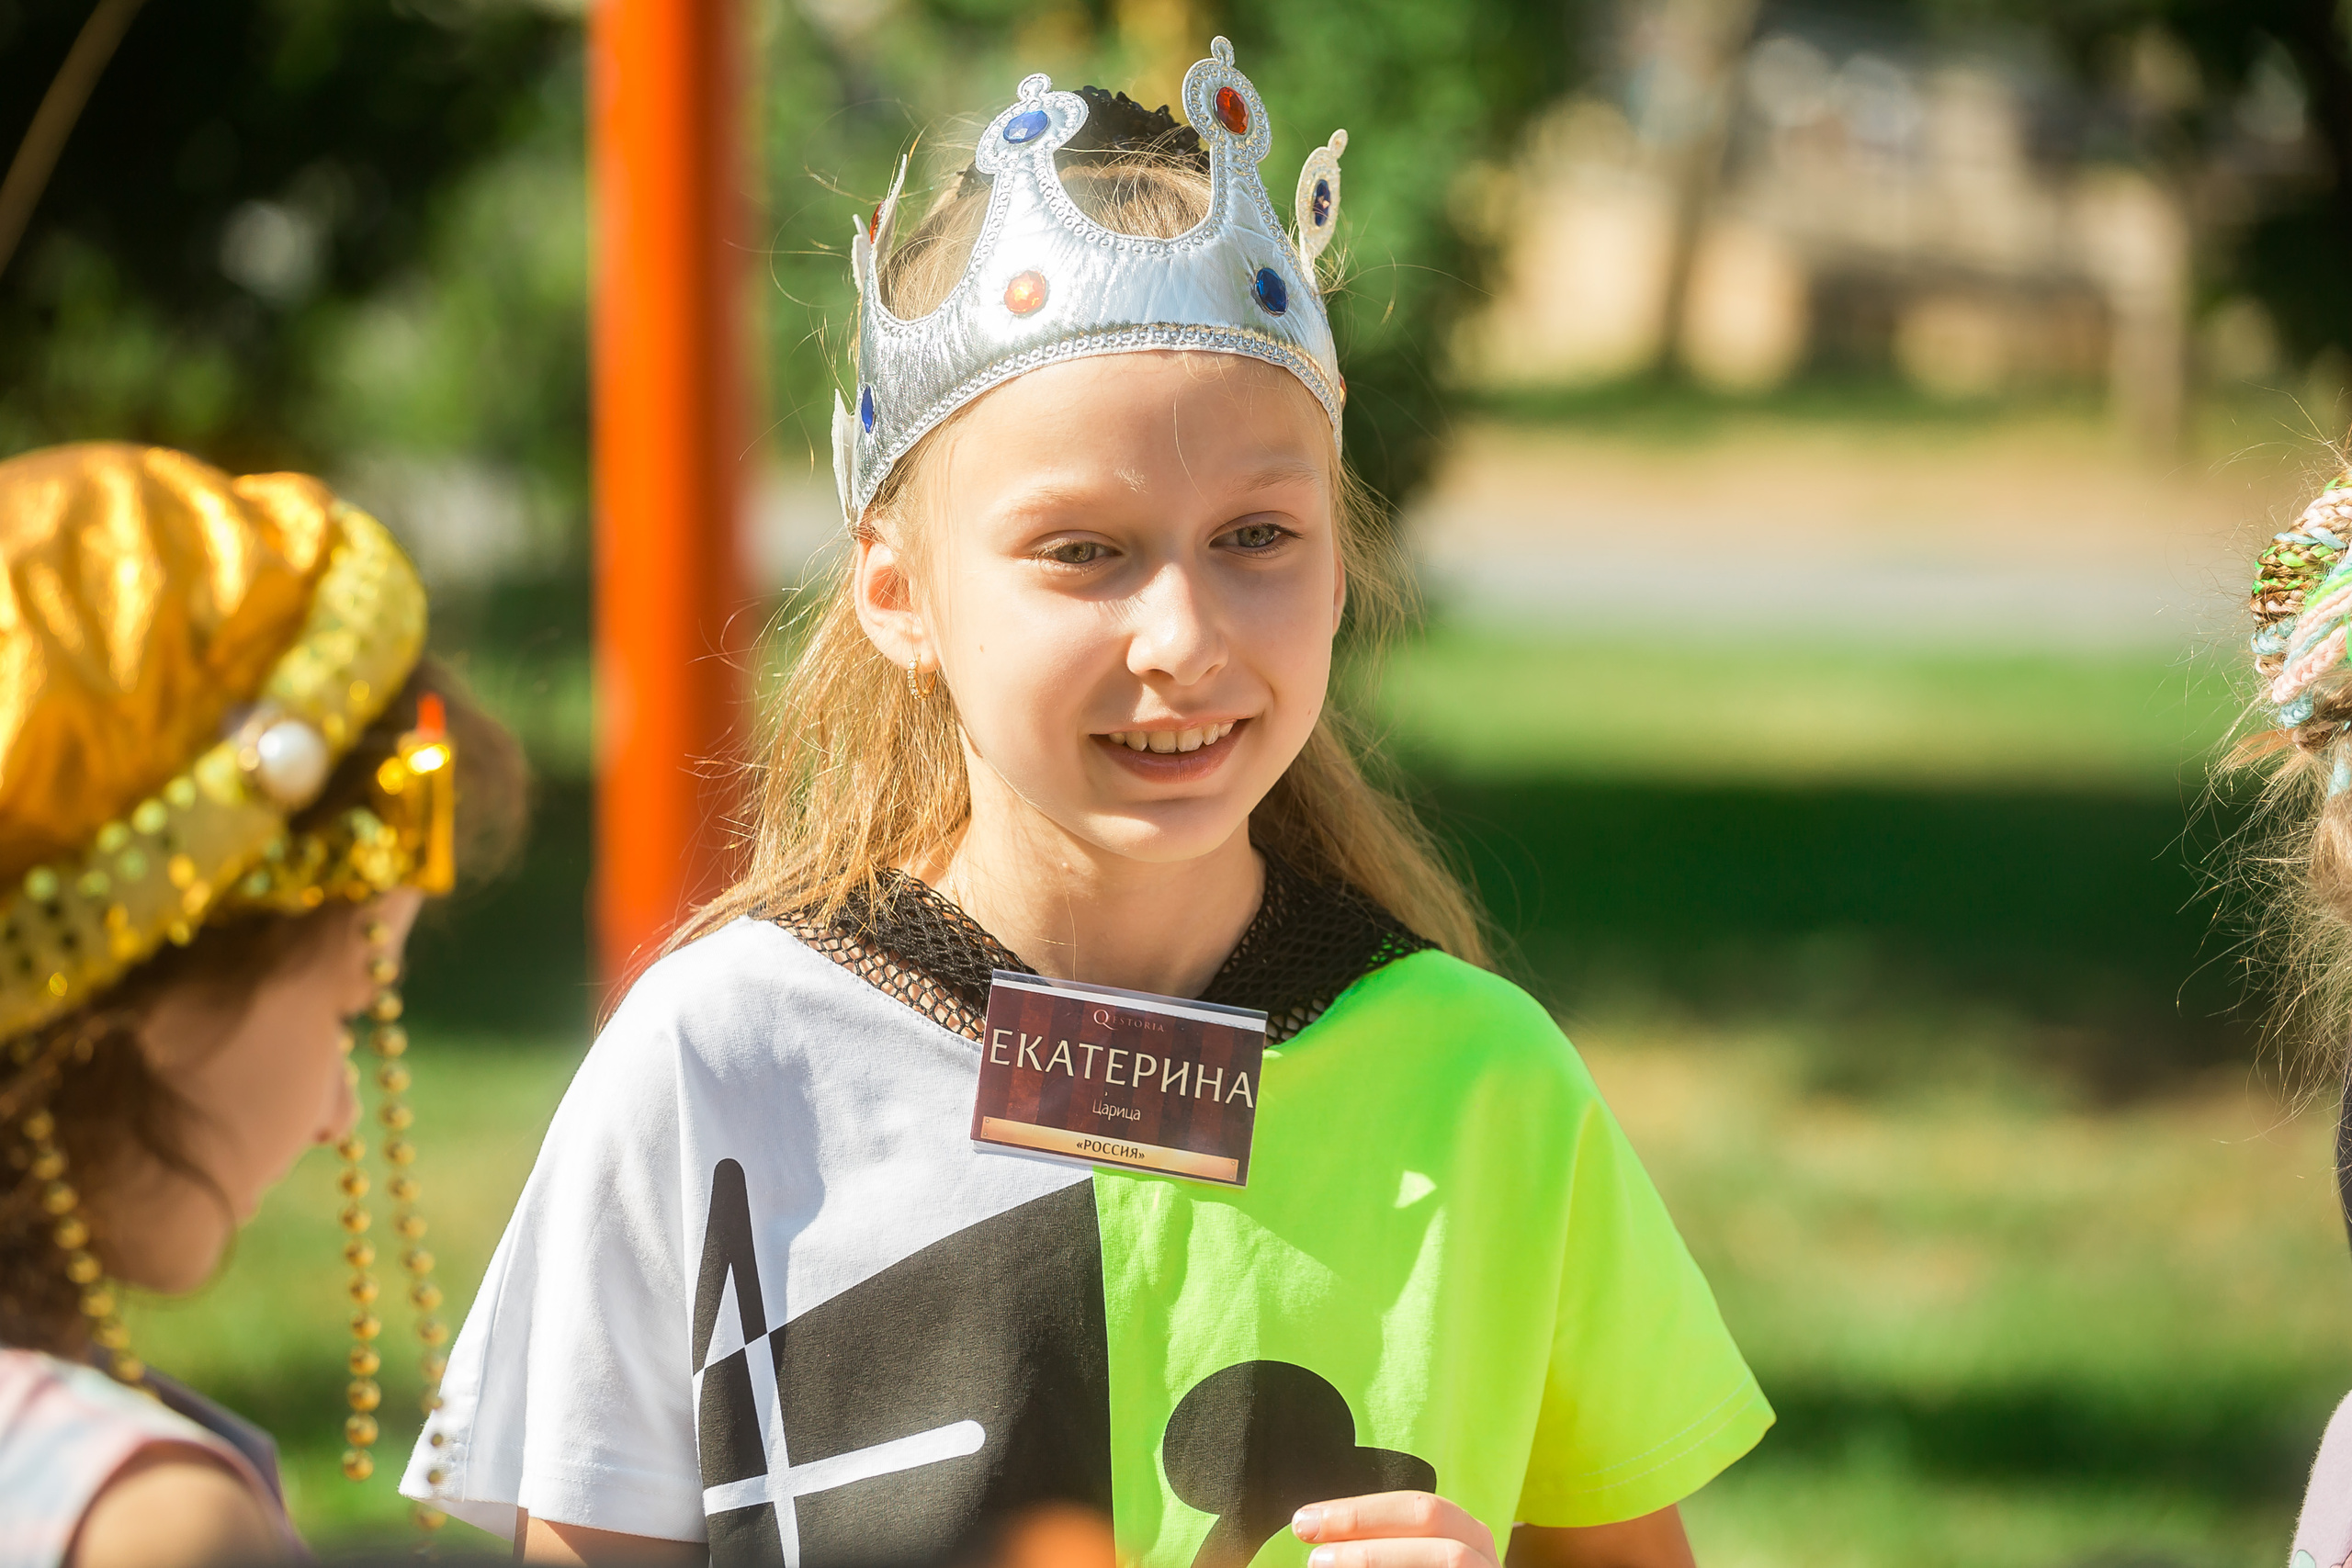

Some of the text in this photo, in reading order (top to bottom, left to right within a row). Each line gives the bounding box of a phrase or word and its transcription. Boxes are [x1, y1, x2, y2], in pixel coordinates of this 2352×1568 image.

[989, 1028, 1254, 1108] ЕКАТЕРИНА
[1091, 1099, 1141, 1121] Царица
[1077, 1139, 1145, 1159] «РОССИЯ»
